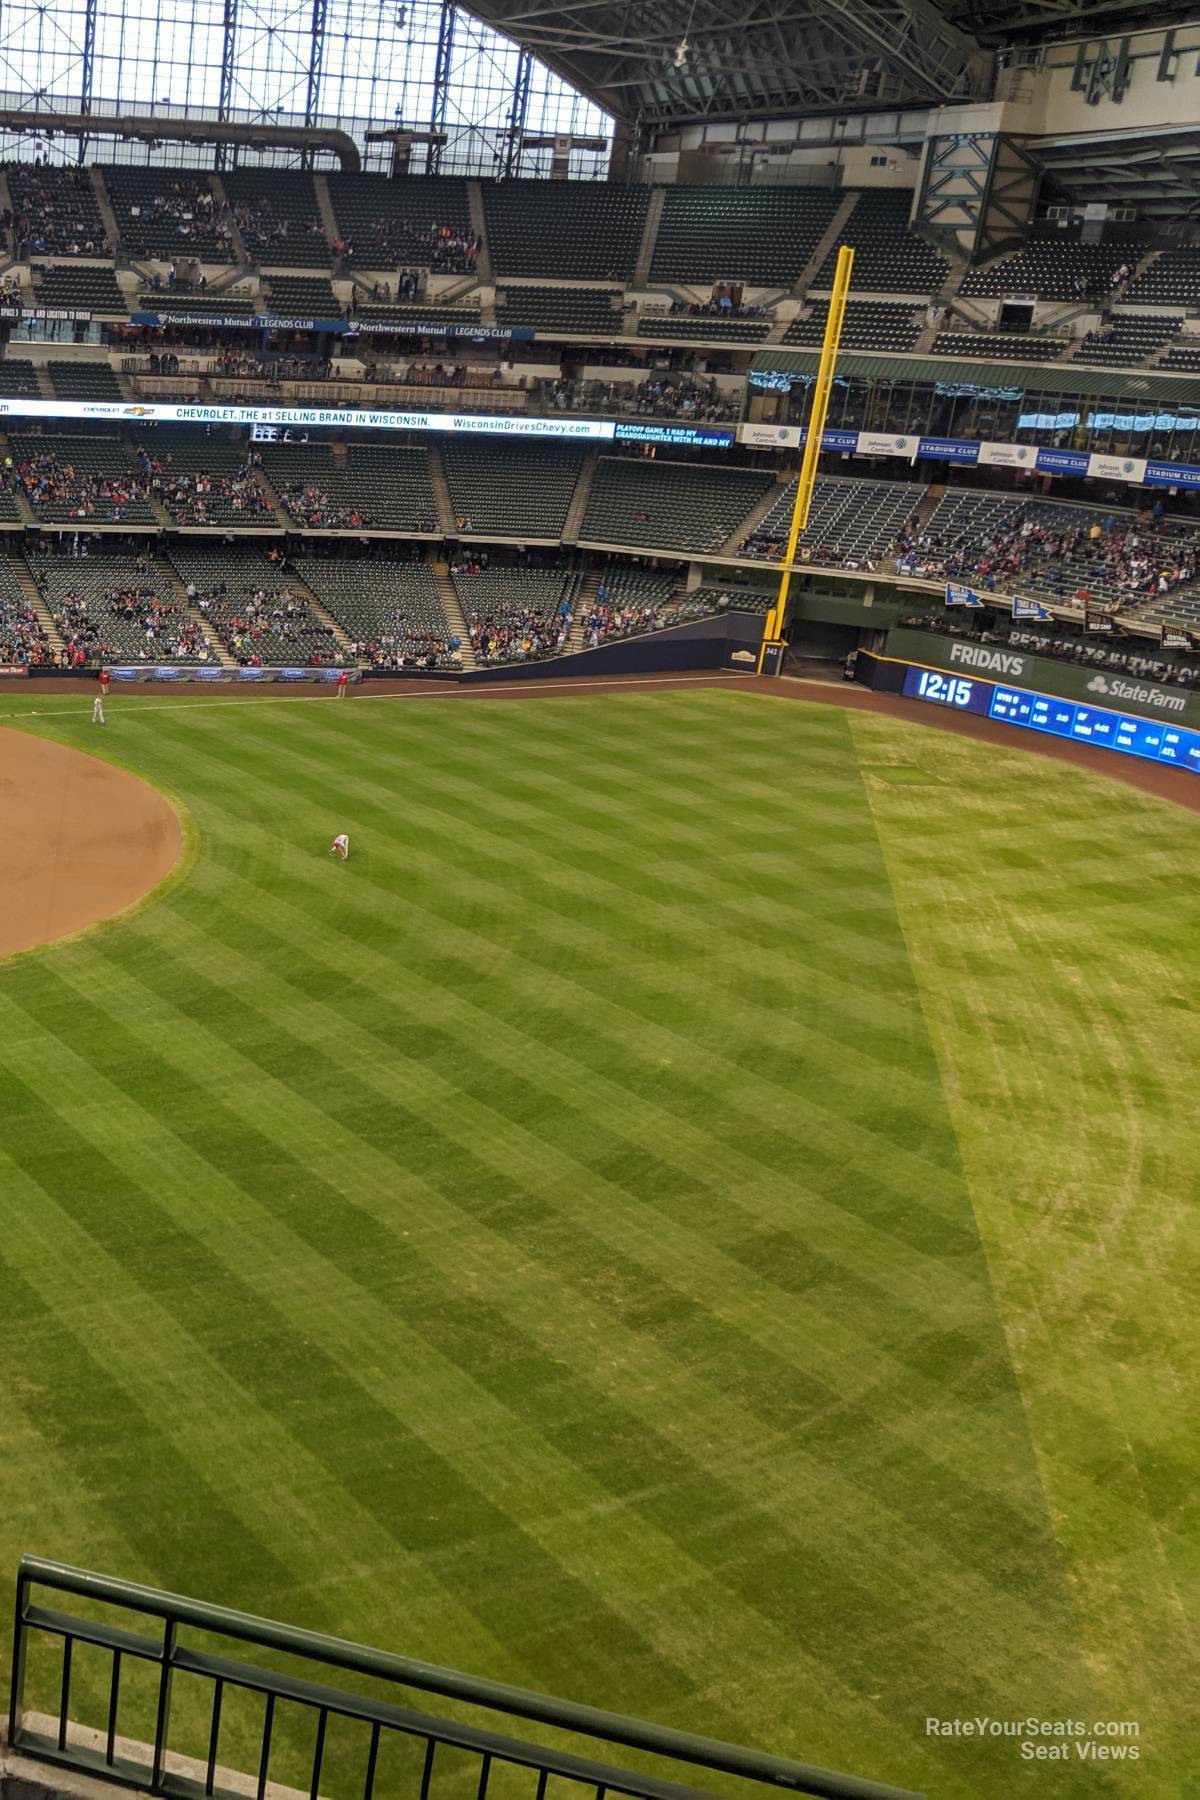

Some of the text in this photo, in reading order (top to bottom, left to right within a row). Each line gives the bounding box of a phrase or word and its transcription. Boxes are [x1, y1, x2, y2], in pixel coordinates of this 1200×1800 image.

[168, 316, 314, 329] Northwestern Mutual LEGENDS CLUB
[359, 323, 512, 337] Northwestern Mutual LEGENDS CLUB
[176, 408, 431, 426] CHEVROLET. THE #1 SELLING BRAND IN WISCONSIN.
[453, 418, 590, 434] WisconsinDrivesChevy.com
[617, 424, 644, 433] PLAYOFF
[671, 428, 685, 436] HAD
[616, 431, 672, 441] GRANDDAUGHTER
[673, 436, 692, 444] WITH
[693, 437, 703, 445] ME
[921, 445, 956, 453] STADIUM
[1039, 456, 1069, 464] STADIUM
[1147, 469, 1181, 478] STADIUM
[950, 643, 1024, 676] FRIDAYS
[919, 672, 972, 705] 12:15
